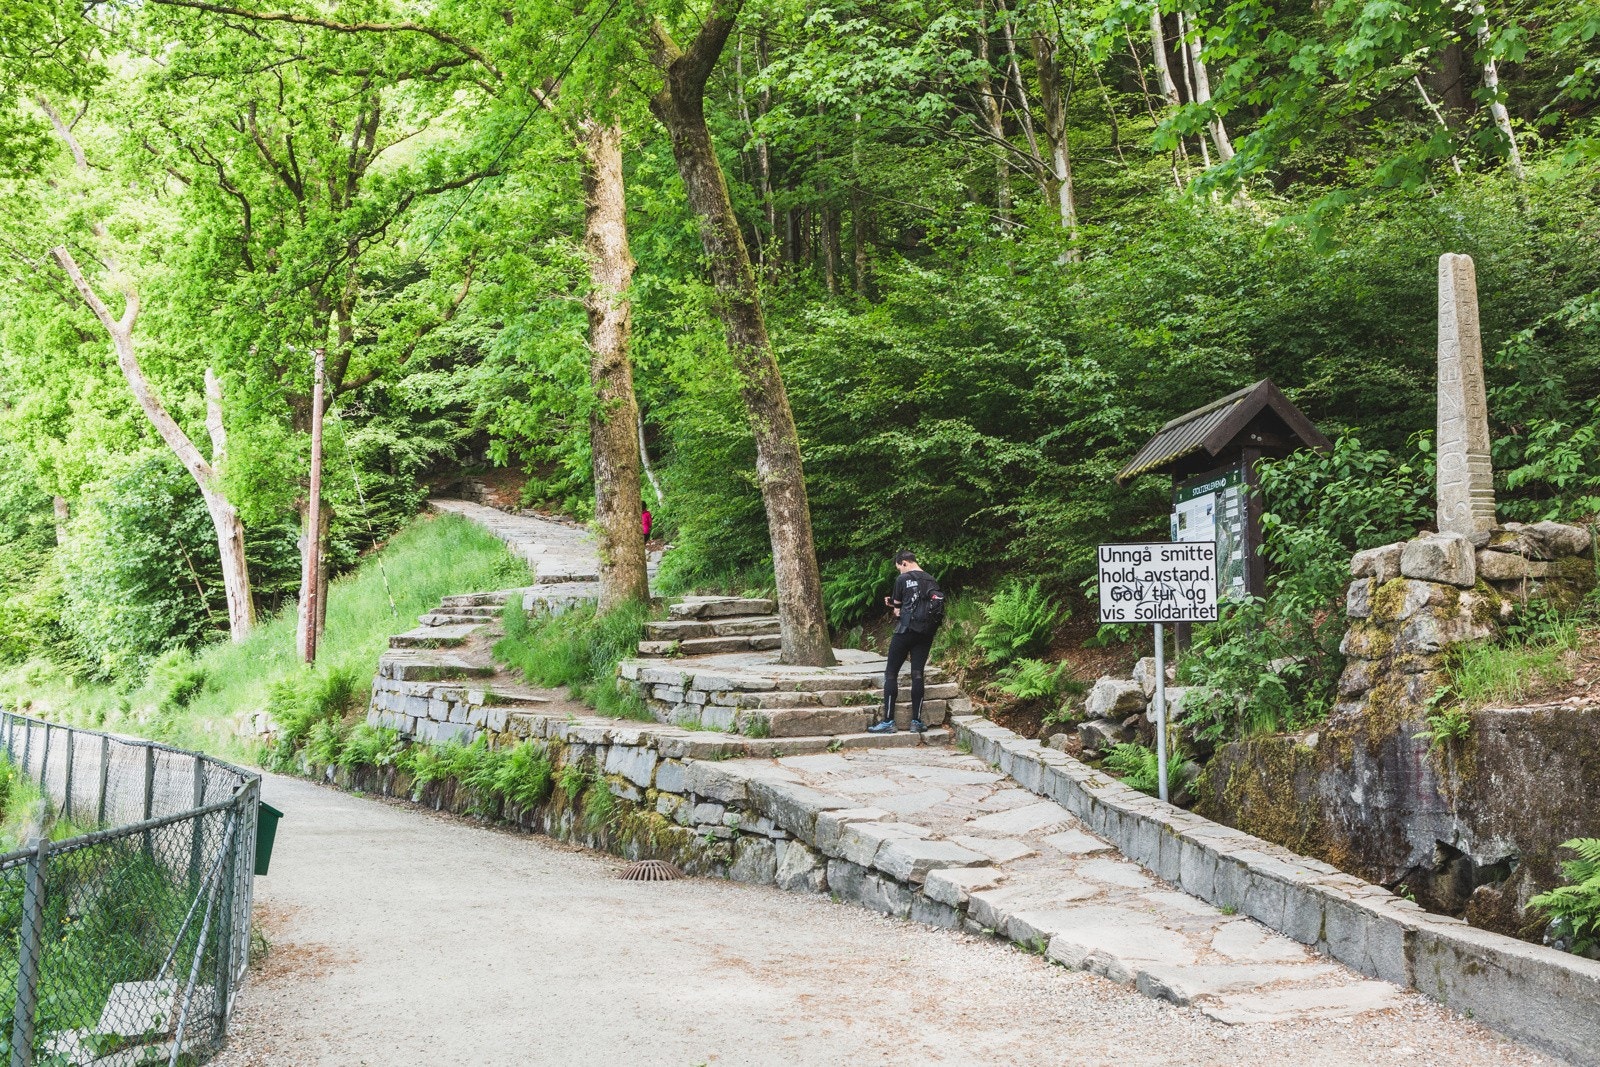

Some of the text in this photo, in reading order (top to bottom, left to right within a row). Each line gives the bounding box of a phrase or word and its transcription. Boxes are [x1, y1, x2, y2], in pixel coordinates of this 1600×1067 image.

[1100, 546, 1213, 566] Unngå smitte
[1101, 567, 1135, 582] hold
[1145, 566, 1214, 582] avstand.
[1110, 585, 1206, 604] God tur og
[1102, 605, 1125, 620] vis
[1134, 603, 1216, 619] solidaritet
